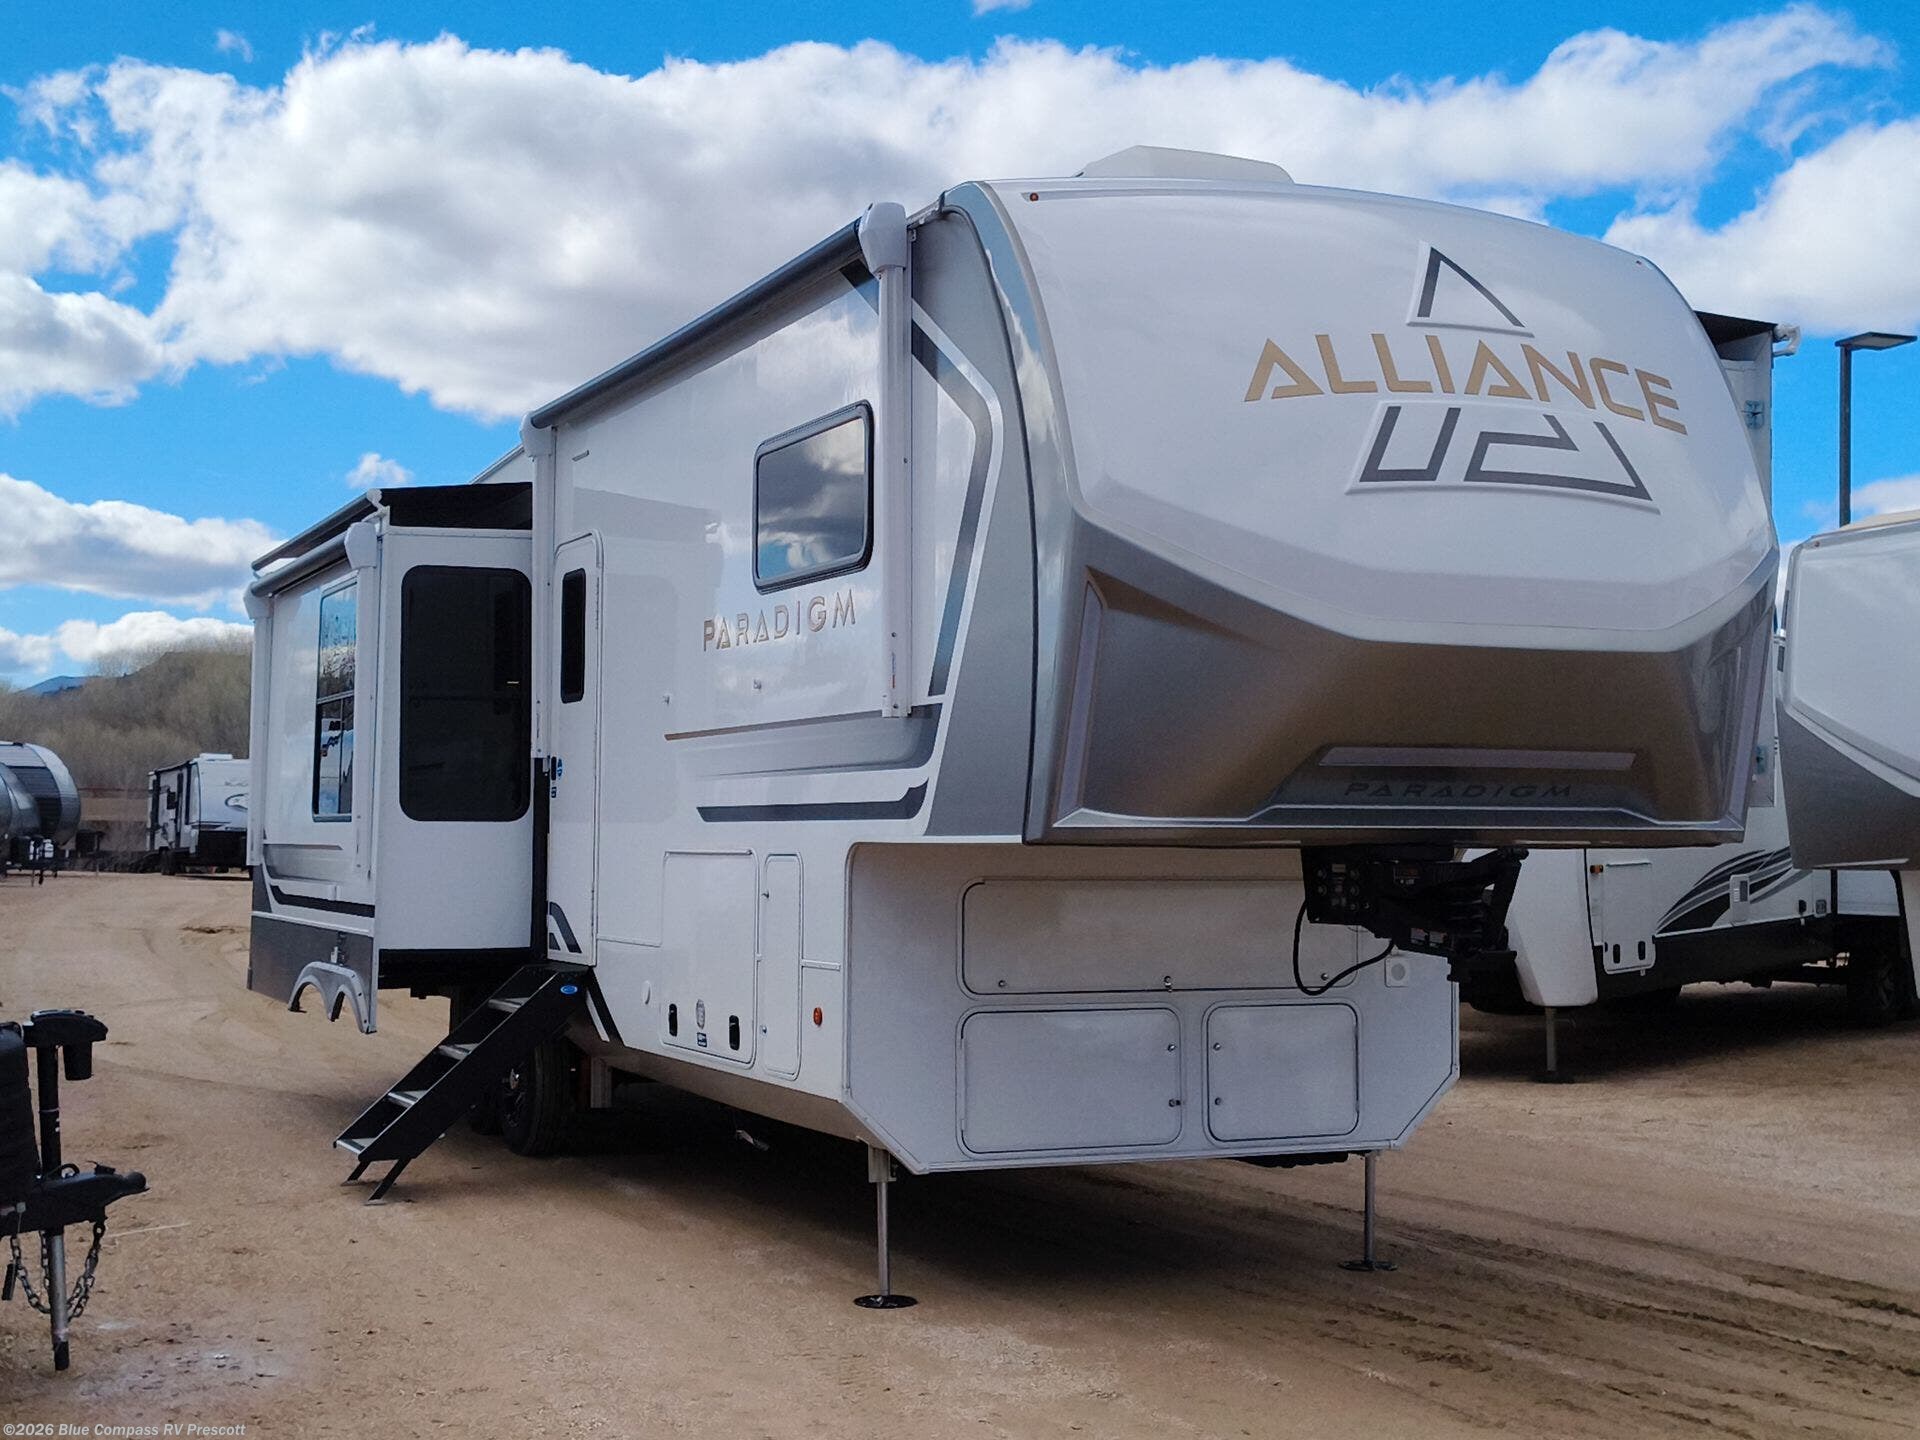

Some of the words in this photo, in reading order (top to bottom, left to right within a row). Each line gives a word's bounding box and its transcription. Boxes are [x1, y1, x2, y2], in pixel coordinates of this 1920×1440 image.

[1244, 333, 1688, 435] ALLIANCE
[703, 589, 856, 652] PARADIGM
[1344, 782, 1571, 798] PARADIGM
